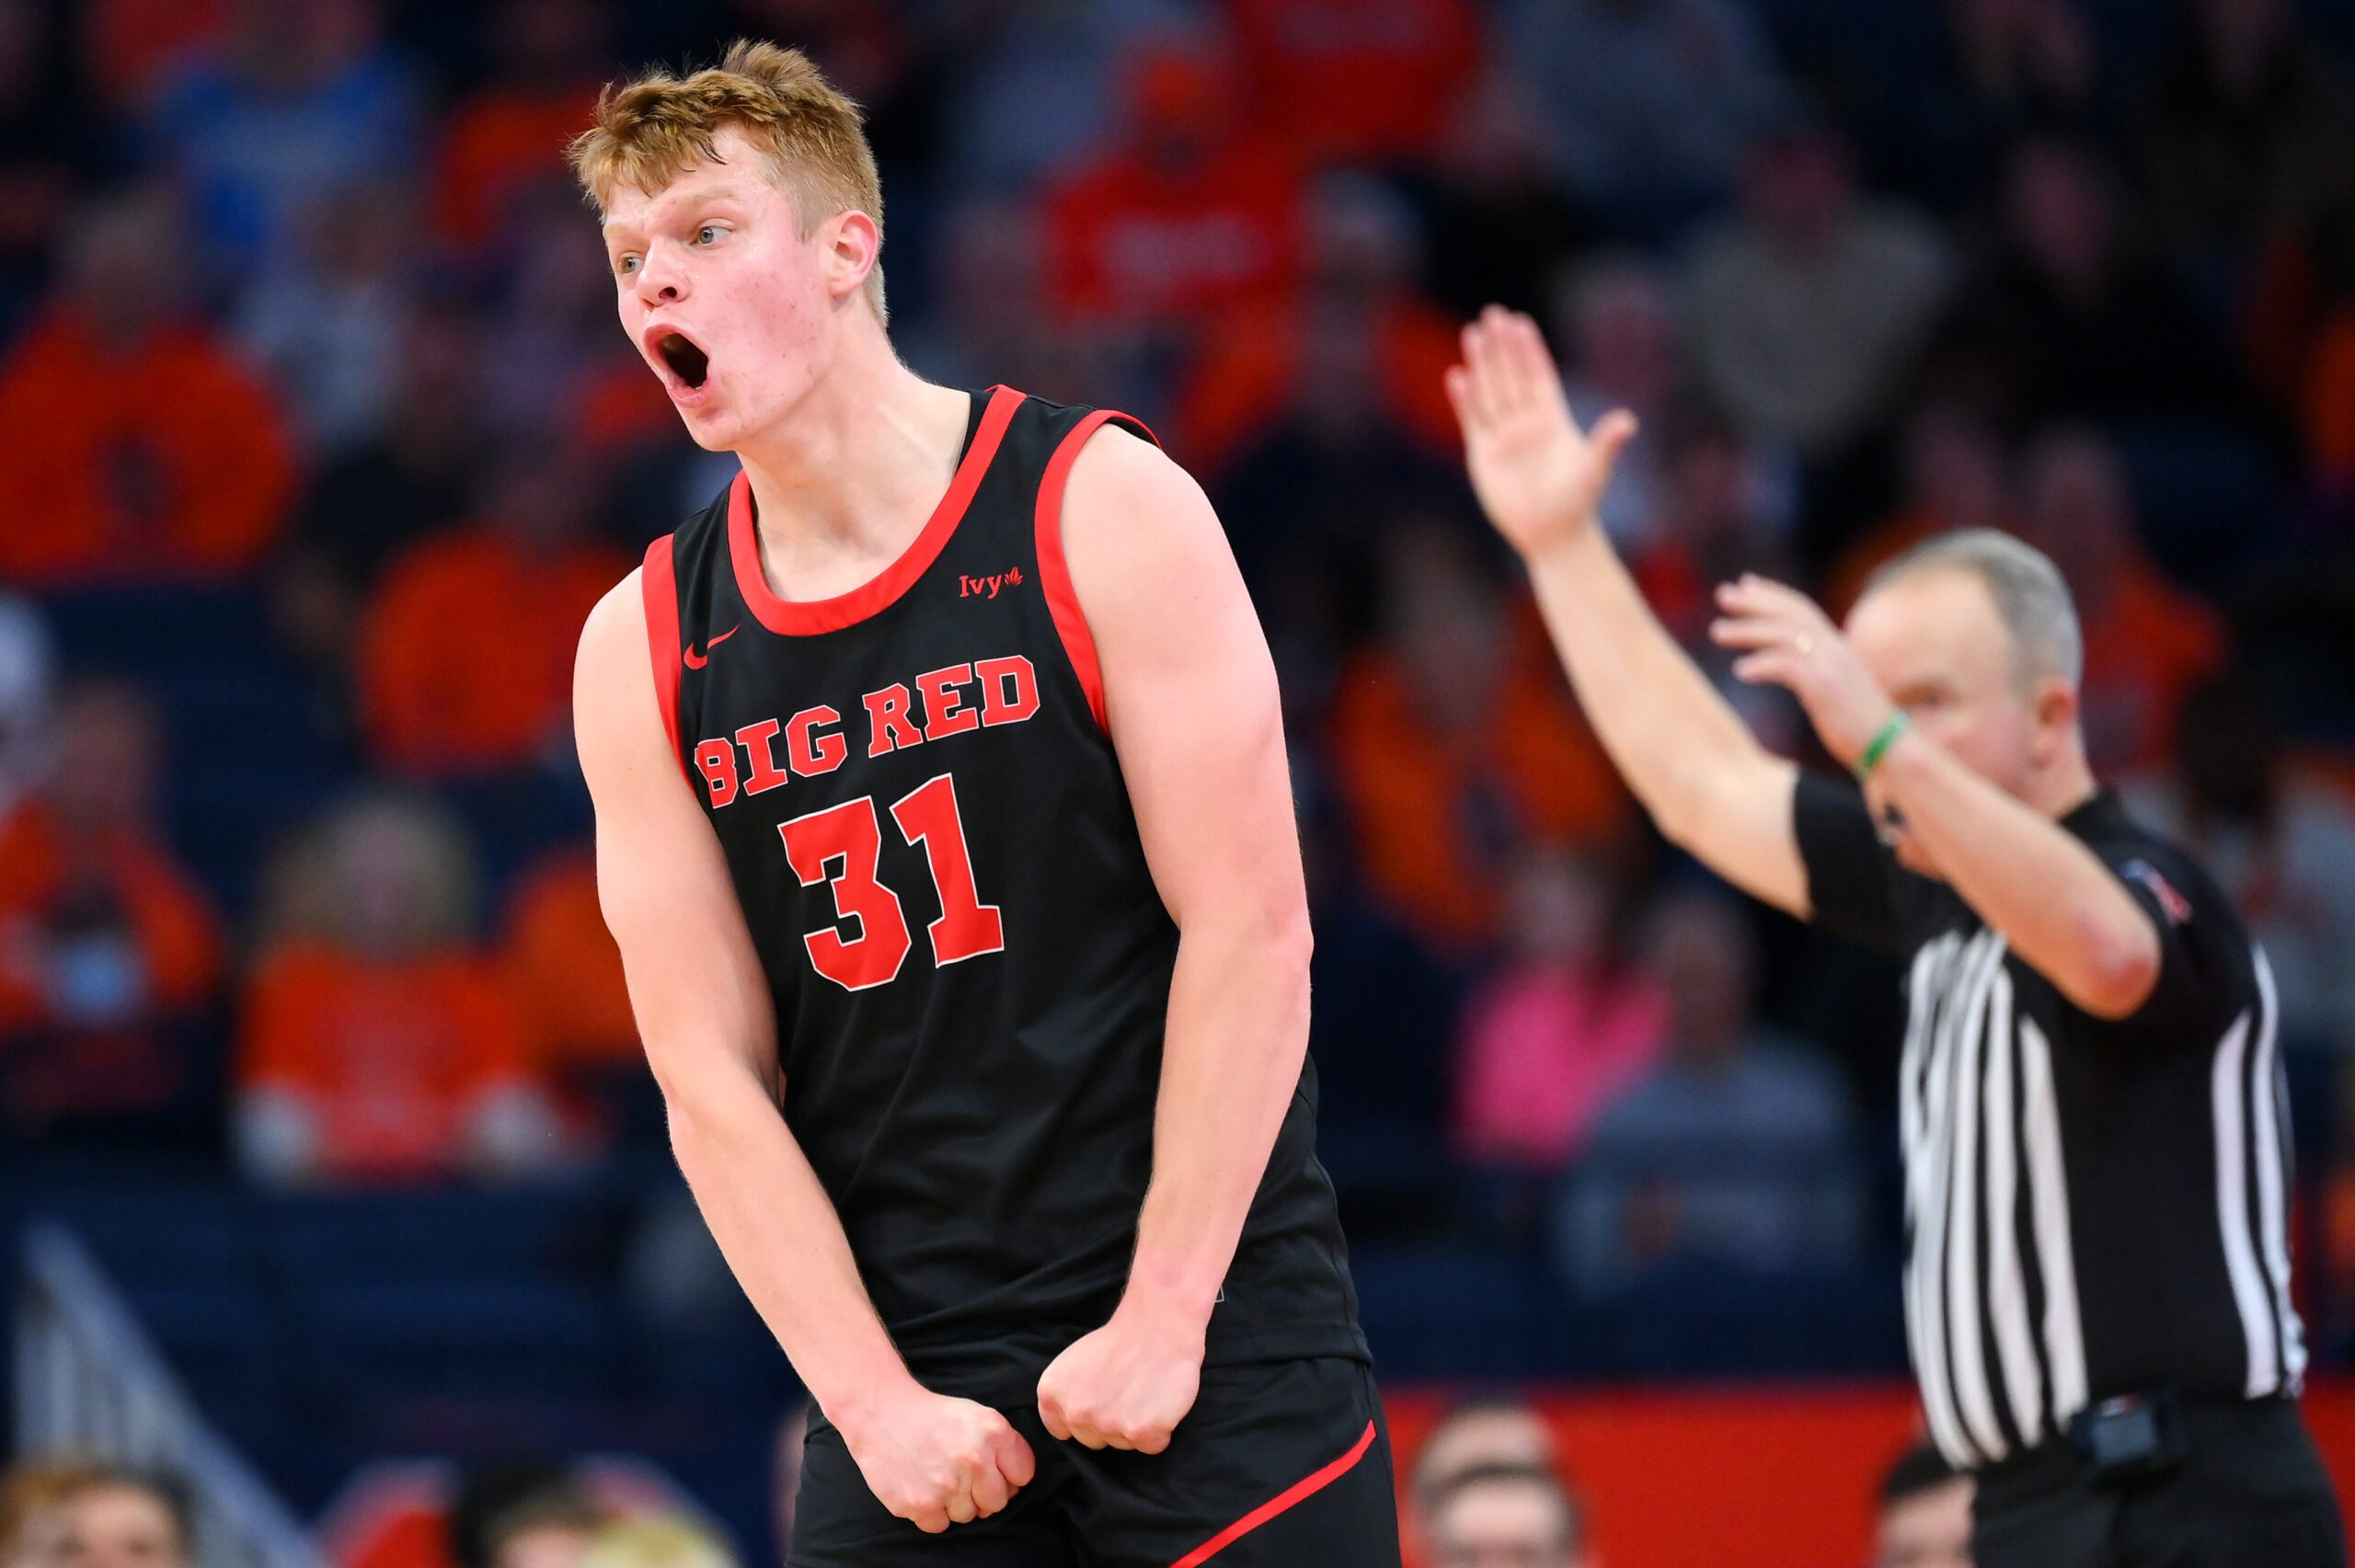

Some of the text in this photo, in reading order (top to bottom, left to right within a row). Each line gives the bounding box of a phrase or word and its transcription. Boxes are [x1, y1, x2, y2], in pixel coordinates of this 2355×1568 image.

[959, 574, 1002, 600] Ivy
[694, 654, 1040, 808] BIG RED
[777, 773, 1004, 991] 31
